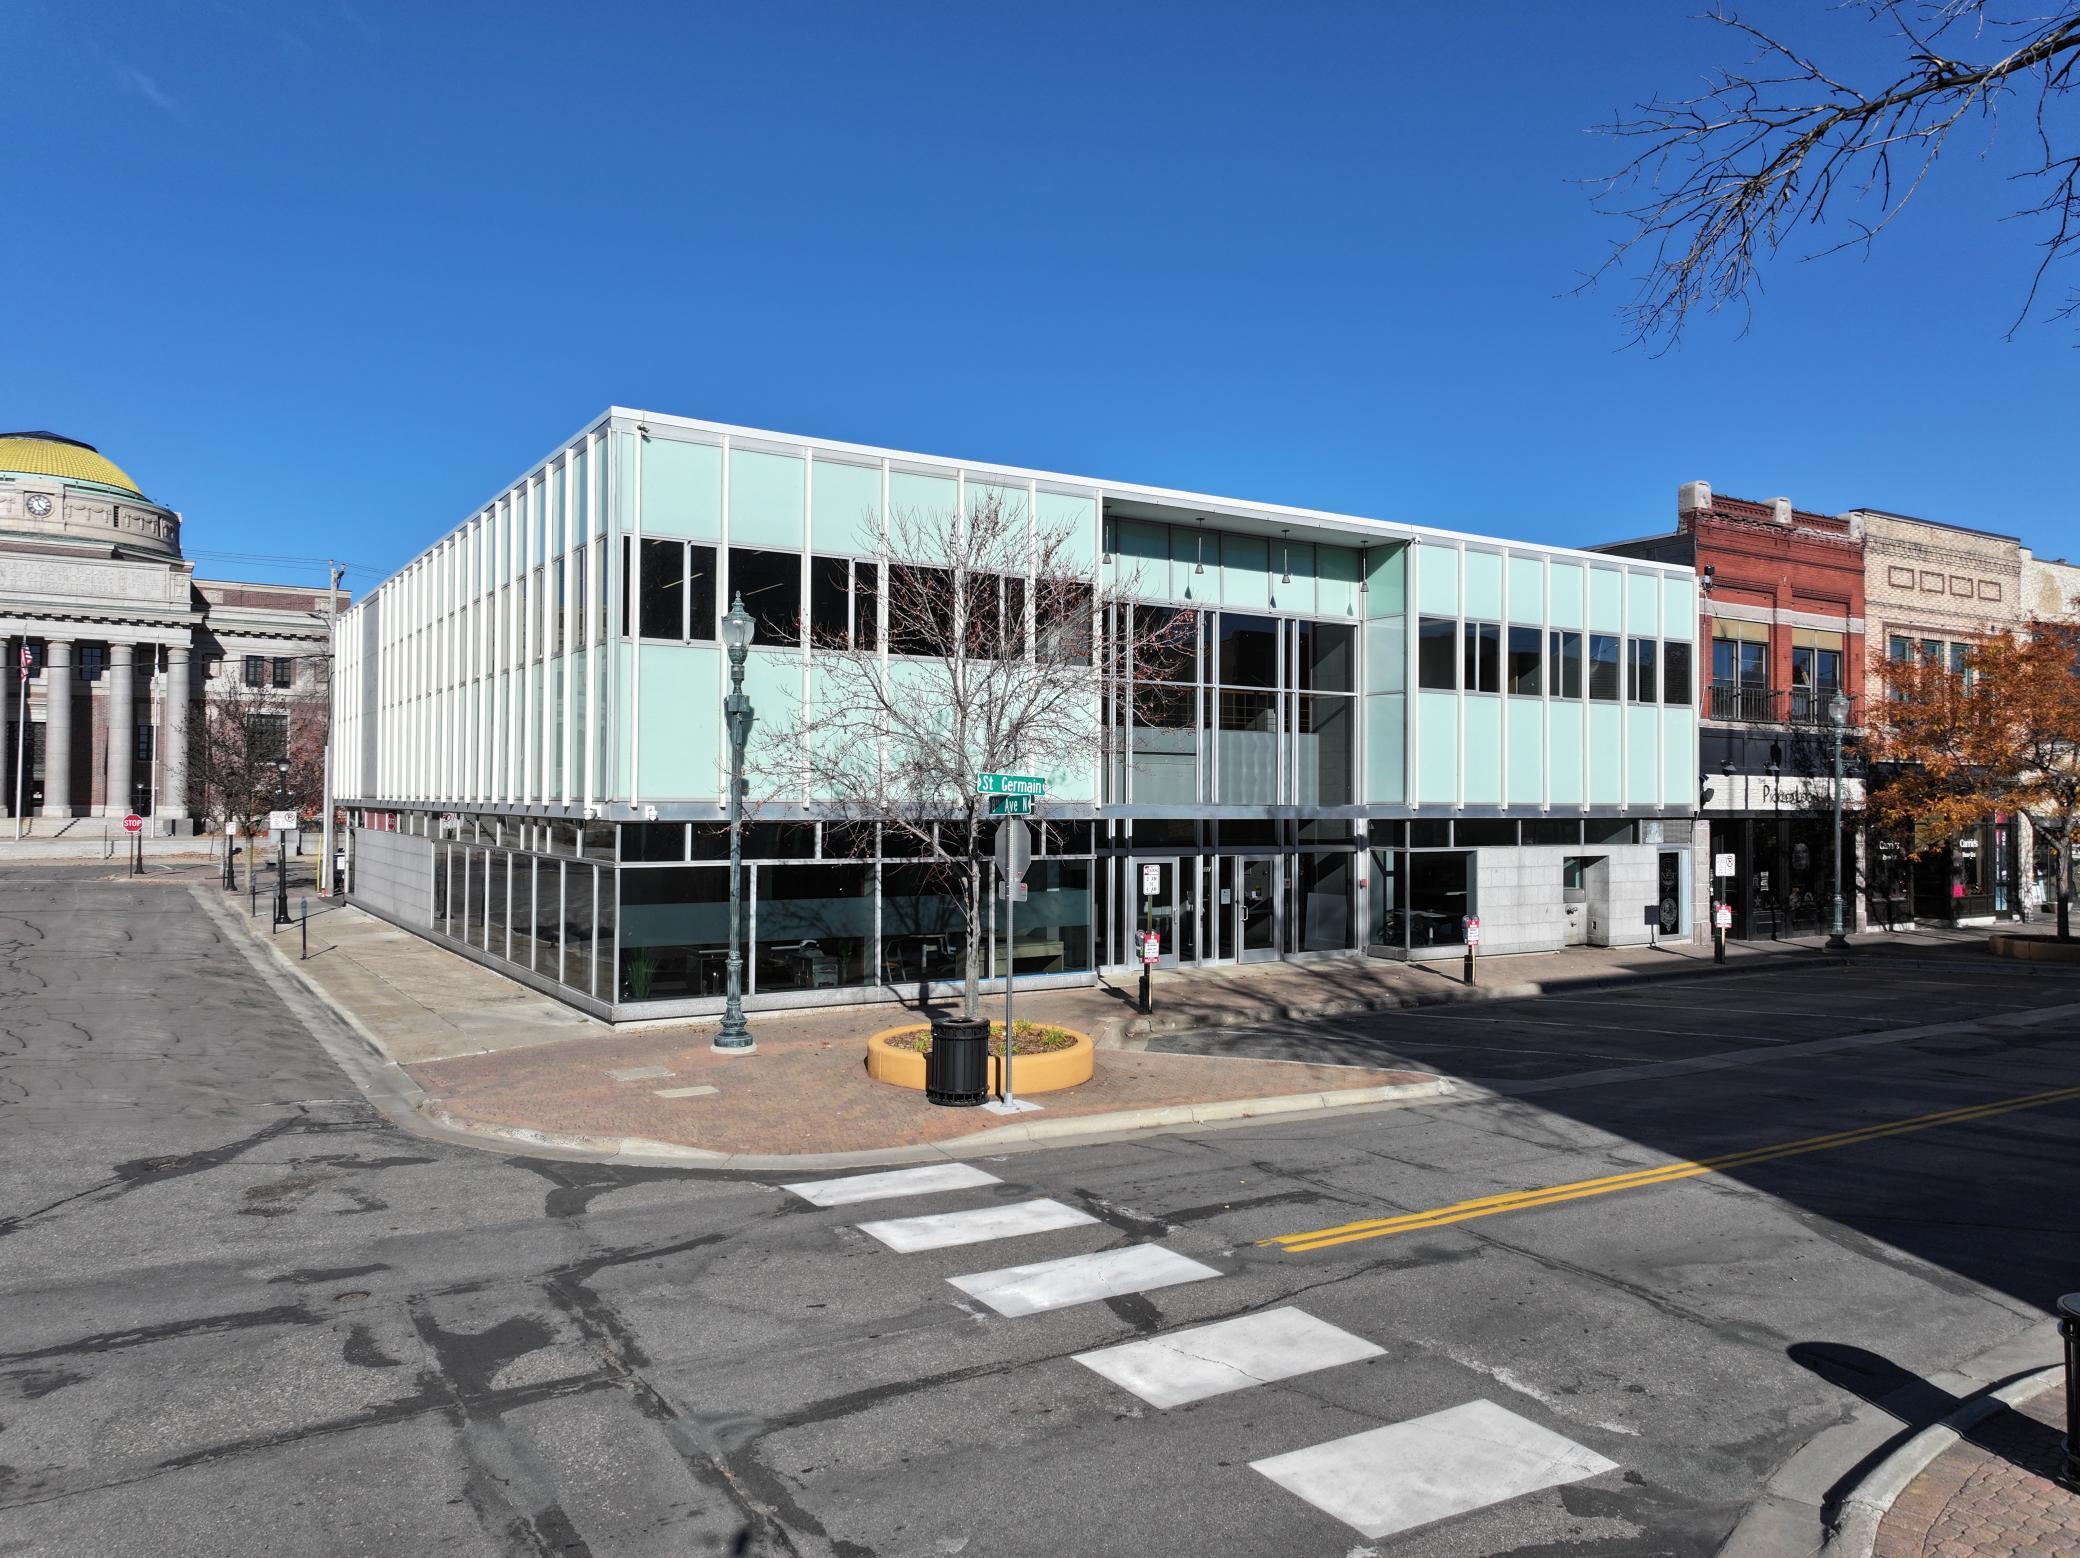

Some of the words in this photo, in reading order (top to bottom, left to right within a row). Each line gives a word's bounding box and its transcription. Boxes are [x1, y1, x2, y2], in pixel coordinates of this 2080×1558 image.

[983, 775, 993, 790] St
[1001, 776, 1042, 793] Germain
[1005, 798, 1018, 813] Ave
[1022, 797, 1028, 812] N
[123, 819, 142, 827] STOP
